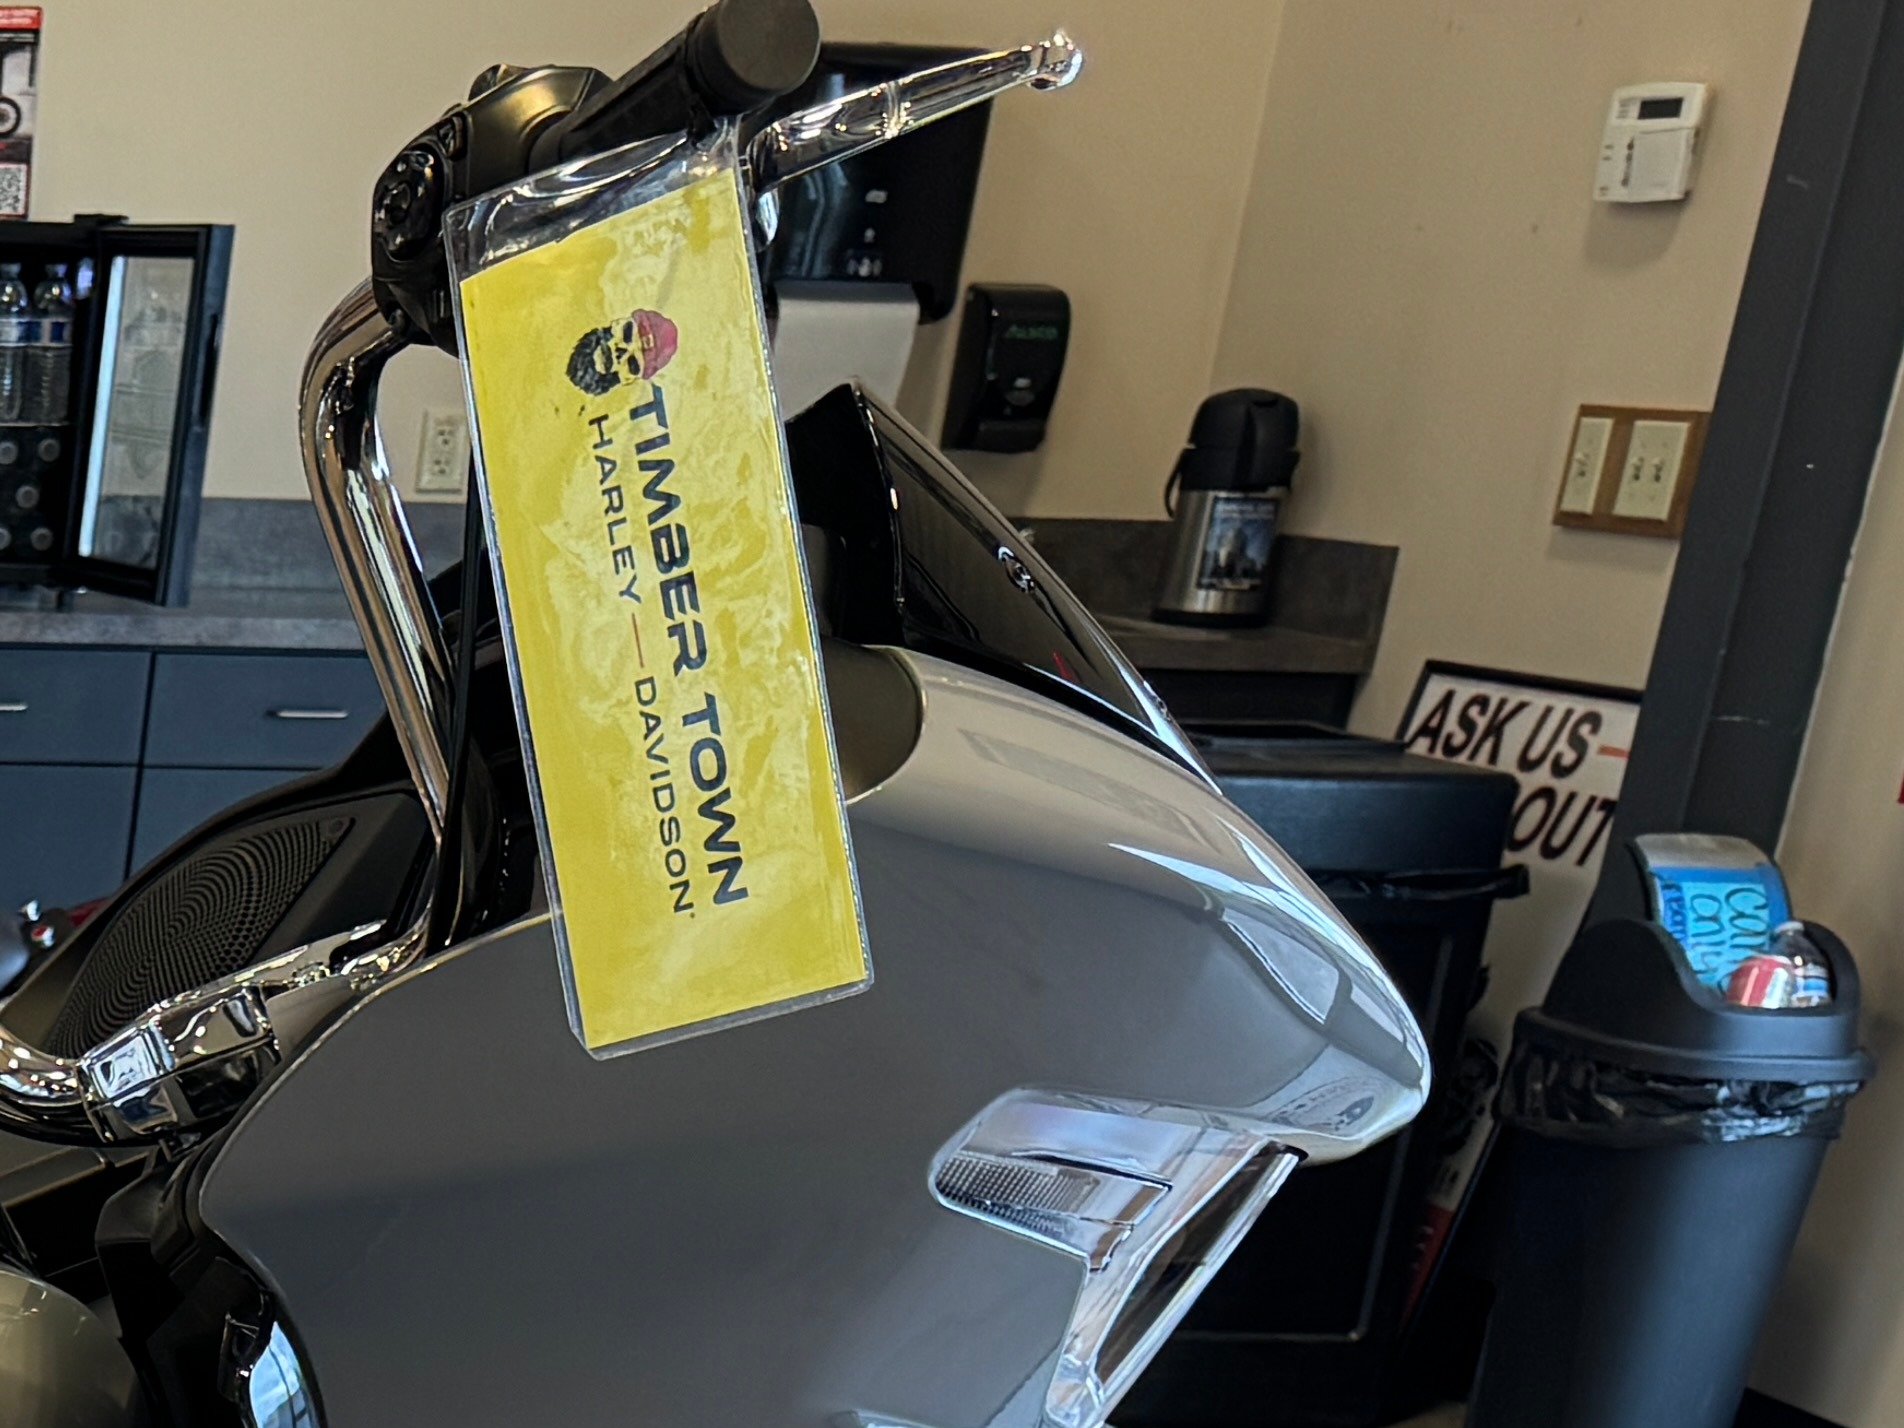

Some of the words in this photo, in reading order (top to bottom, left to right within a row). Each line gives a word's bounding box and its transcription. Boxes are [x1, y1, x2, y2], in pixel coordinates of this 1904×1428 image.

[588, 414, 643, 605] HARLEY
[634, 675, 694, 916] DAVIDSON
[629, 383, 710, 677] TIMBER
[681, 691, 750, 907] TOWN
[1403, 688, 1532, 767] ASK
[1516, 704, 1603, 779] US
[1505, 786, 1619, 868] OUT
